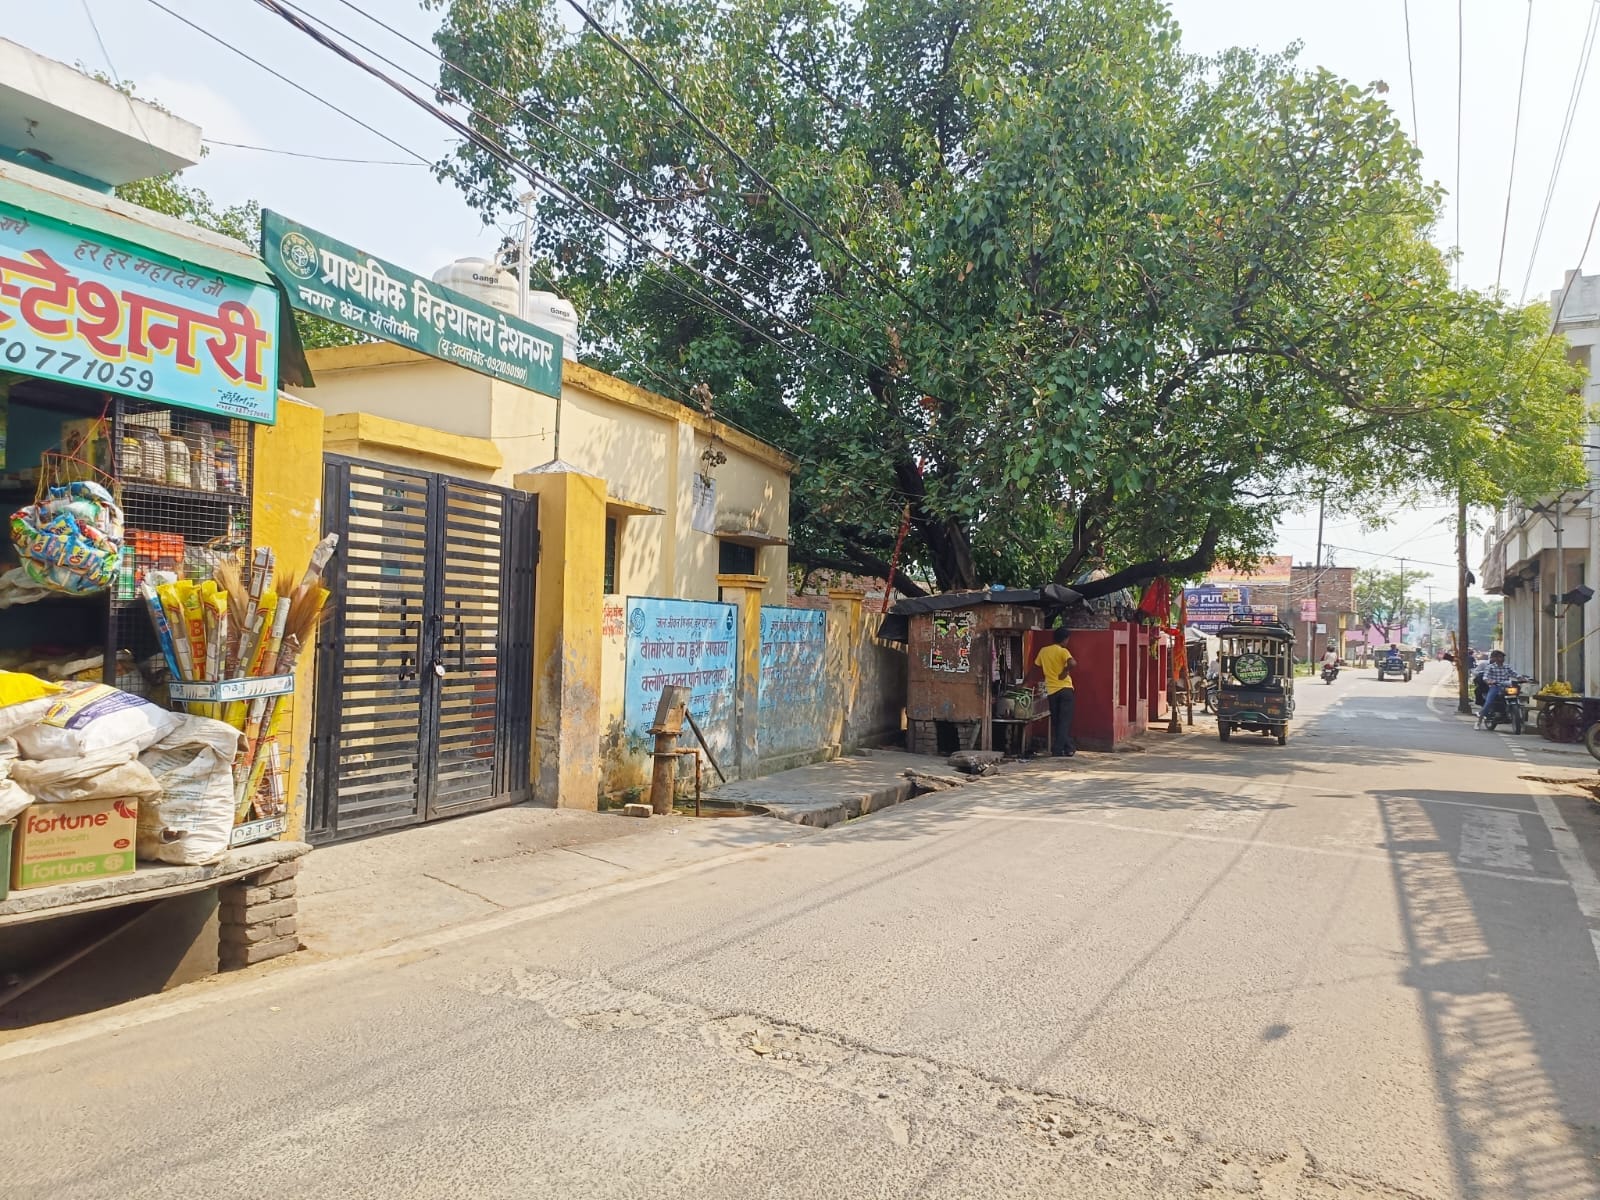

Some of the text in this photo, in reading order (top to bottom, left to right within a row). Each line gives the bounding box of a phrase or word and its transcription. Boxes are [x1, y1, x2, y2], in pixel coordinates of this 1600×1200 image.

[74, 240, 227, 298] हर हर महादेव जी
[472, 273, 499, 285] Ganga
[298, 285, 336, 315] नगर
[369, 310, 419, 344] पीलीभीत
[318, 248, 407, 312] प्राथमिक
[497, 315, 554, 372] देशनगर
[550, 307, 570, 317] Ganga
[0, 337, 154, 392] 0771059
[640, 636, 675, 660] बीमारियों
[676, 641, 688, 658] का
[27, 812, 108, 834] fortune
[31, 861, 97, 879] fortune
